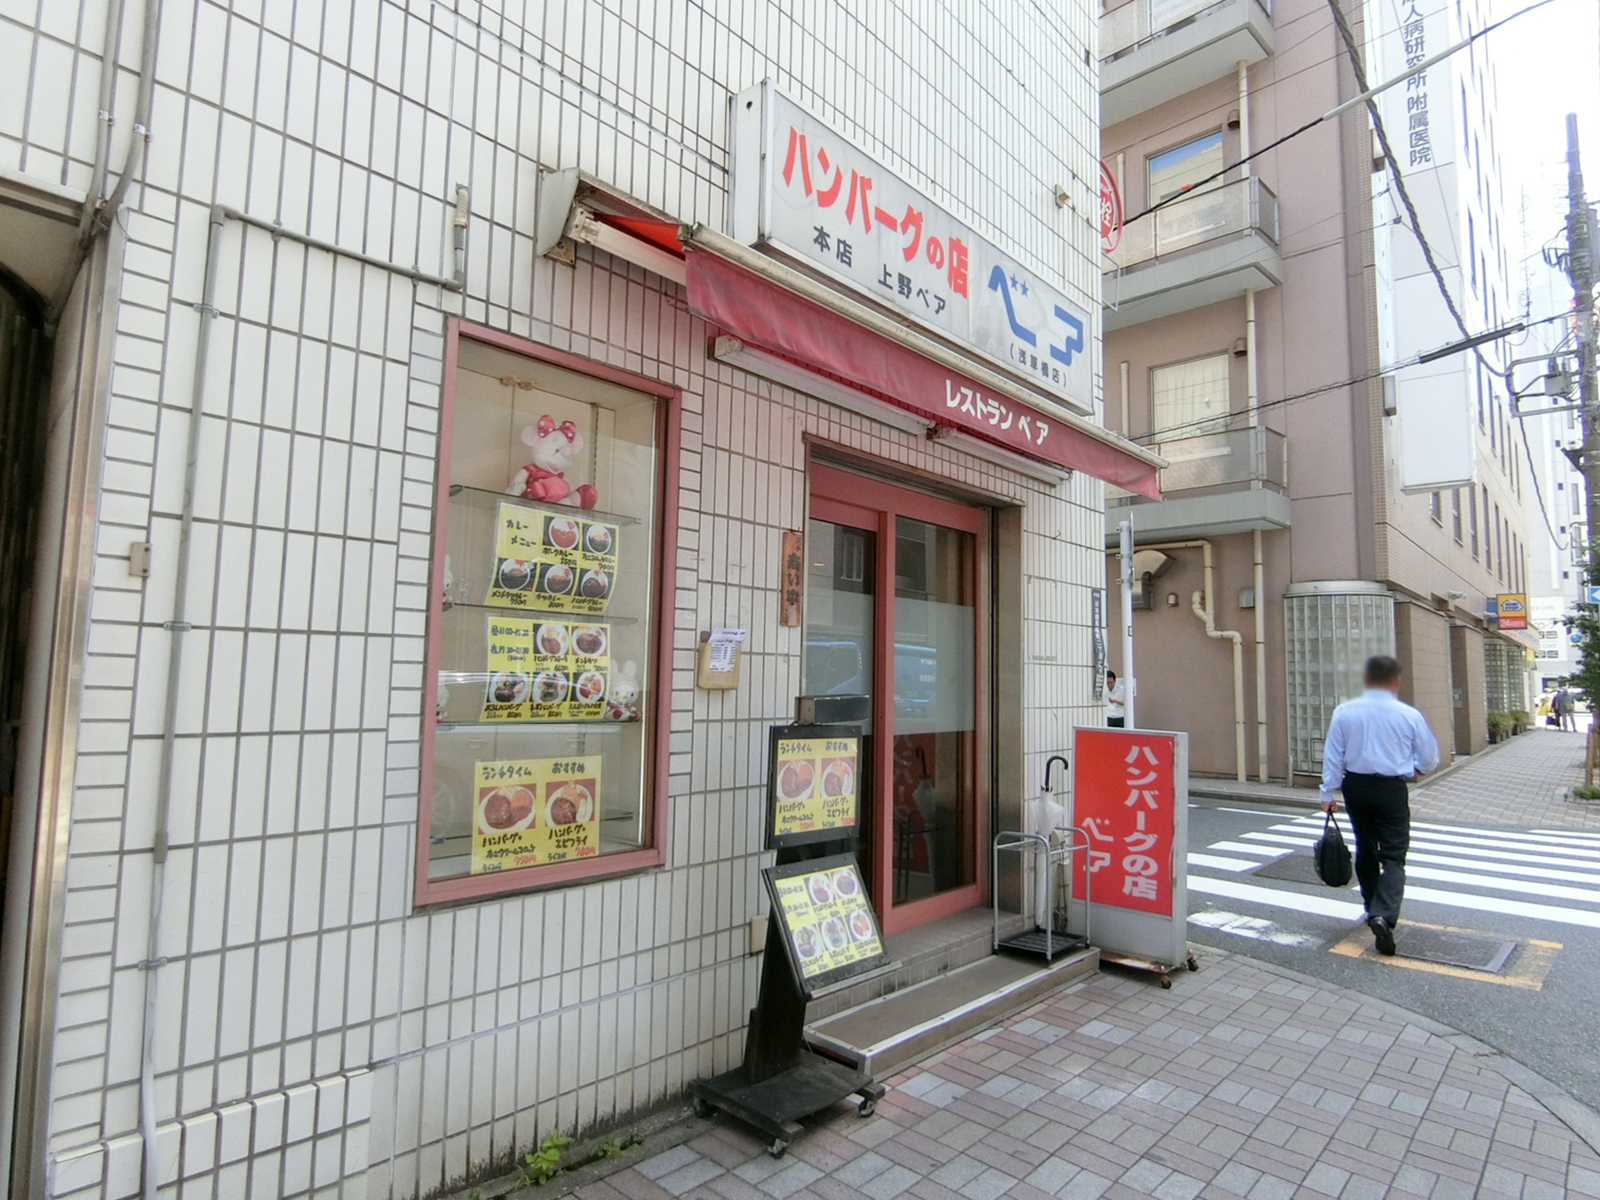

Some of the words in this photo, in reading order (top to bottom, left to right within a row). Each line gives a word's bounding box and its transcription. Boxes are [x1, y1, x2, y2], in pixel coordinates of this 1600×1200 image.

[1402, 0, 1431, 167] 人病研究所附属医院
[782, 125, 968, 299] ハンバーグの店
[813, 225, 853, 268] 本店
[878, 263, 946, 315] 上野ベア
[988, 265, 1083, 367] ベア
[945, 379, 1013, 429] レストラン
[1018, 415, 1049, 445] ベア
[506, 519, 528, 530] カレー
[511, 535, 537, 547] メニュー
[482, 766, 532, 780] ランチタイム
[552, 762, 585, 774] おすすめ
[780, 742, 812, 754] ランチタイム
[825, 741, 848, 752] おすすめ
[555, 835, 588, 849] エビフライ
[1082, 817, 1114, 873] ベア
[1122, 745, 1159, 900] ハンバーグの店
